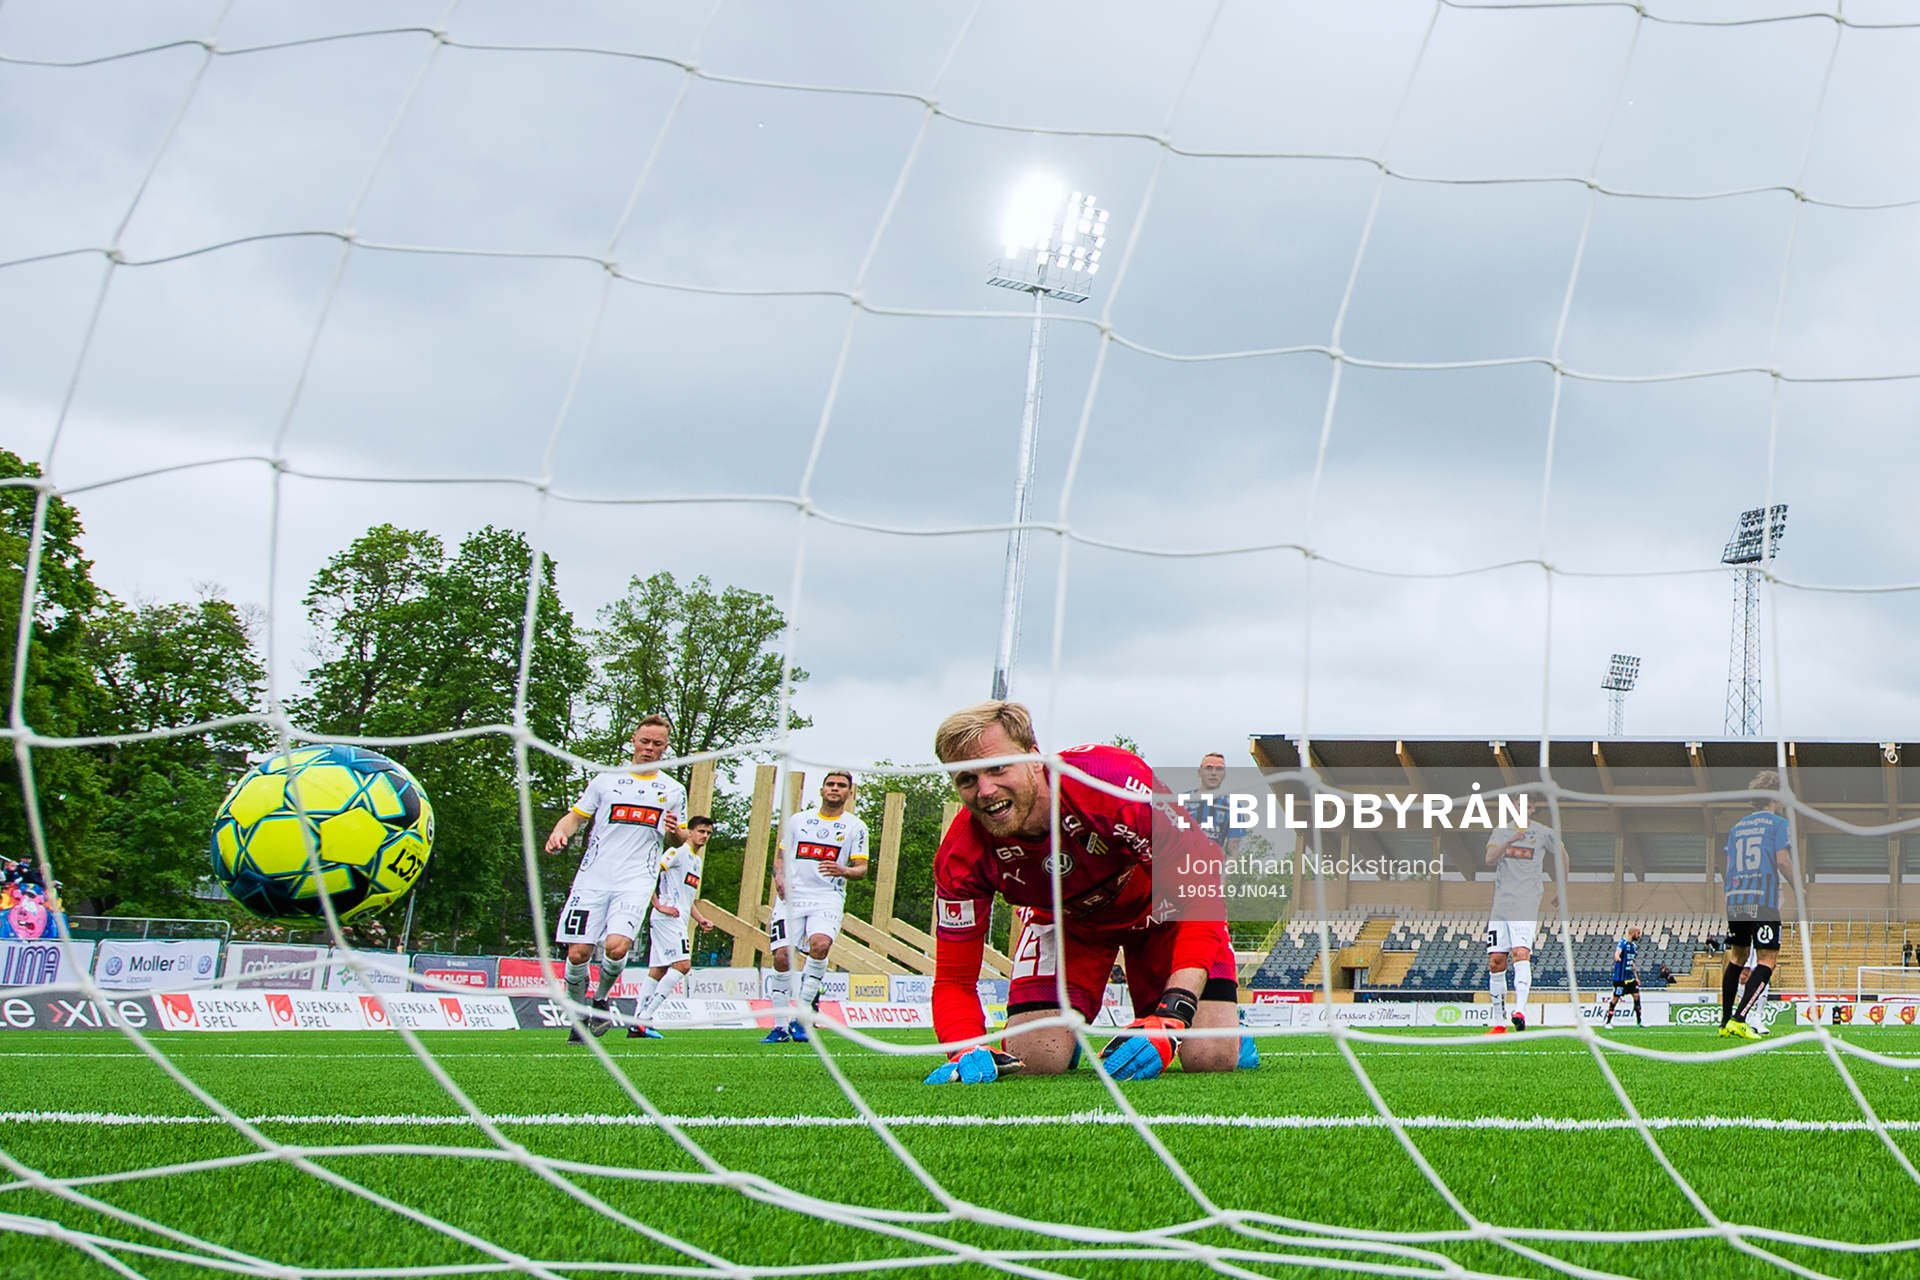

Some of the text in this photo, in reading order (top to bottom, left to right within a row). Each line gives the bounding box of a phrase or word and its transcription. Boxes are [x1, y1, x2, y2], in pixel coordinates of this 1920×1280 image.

[615, 809, 658, 821] BRA
[800, 846, 836, 859] BRA
[1735, 837, 1762, 871] 15
[694, 979, 724, 993] ÅRSTA
[738, 982, 756, 992] TAK
[197, 1000, 262, 1013] SVENSKA
[296, 1001, 352, 1013] SVENSKA
[464, 1003, 510, 1015] SVENSKA
[203, 1015, 238, 1028] SPEL
[300, 1015, 332, 1028] SPEL
[393, 1016, 420, 1027] PEL
[869, 1007, 921, 1023] MOTOR
[469, 1017, 494, 1028] SPEL
